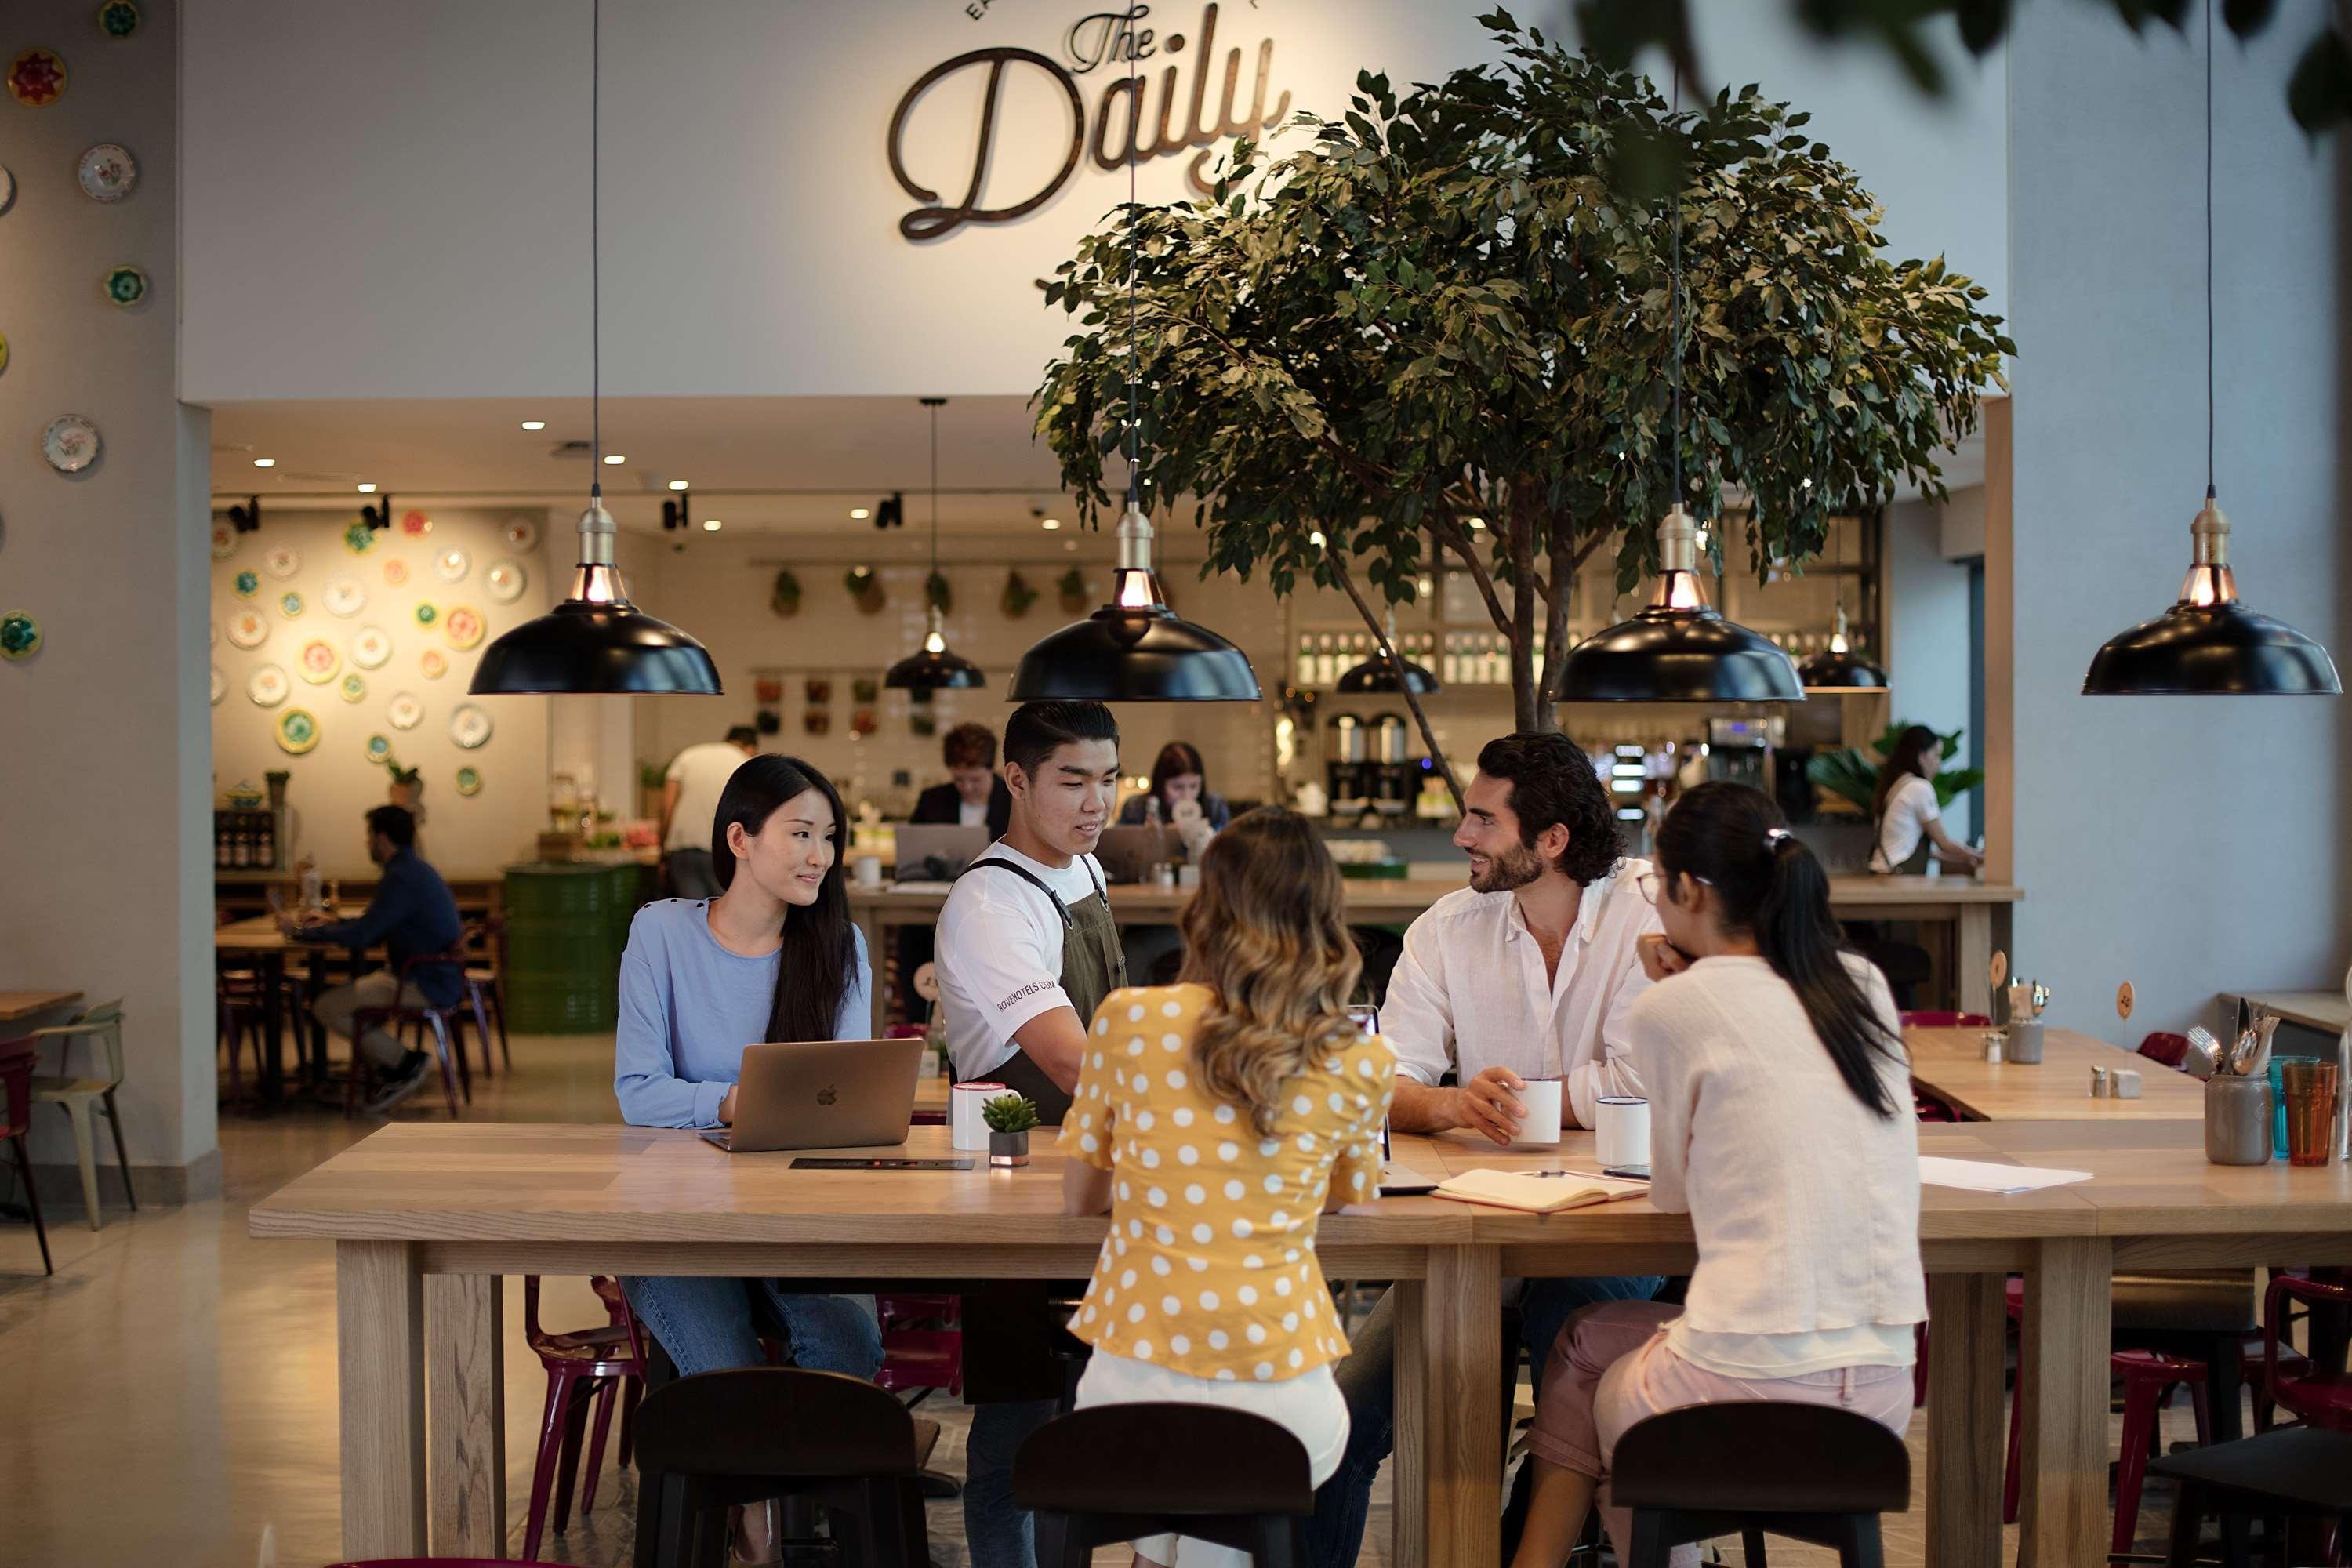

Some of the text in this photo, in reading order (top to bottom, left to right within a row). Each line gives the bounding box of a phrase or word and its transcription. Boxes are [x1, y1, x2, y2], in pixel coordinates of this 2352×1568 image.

[1070, 5, 1156, 73] The
[888, 3, 1291, 240] Daily
[996, 980, 1054, 1012] ROVEHOTELS.COM
